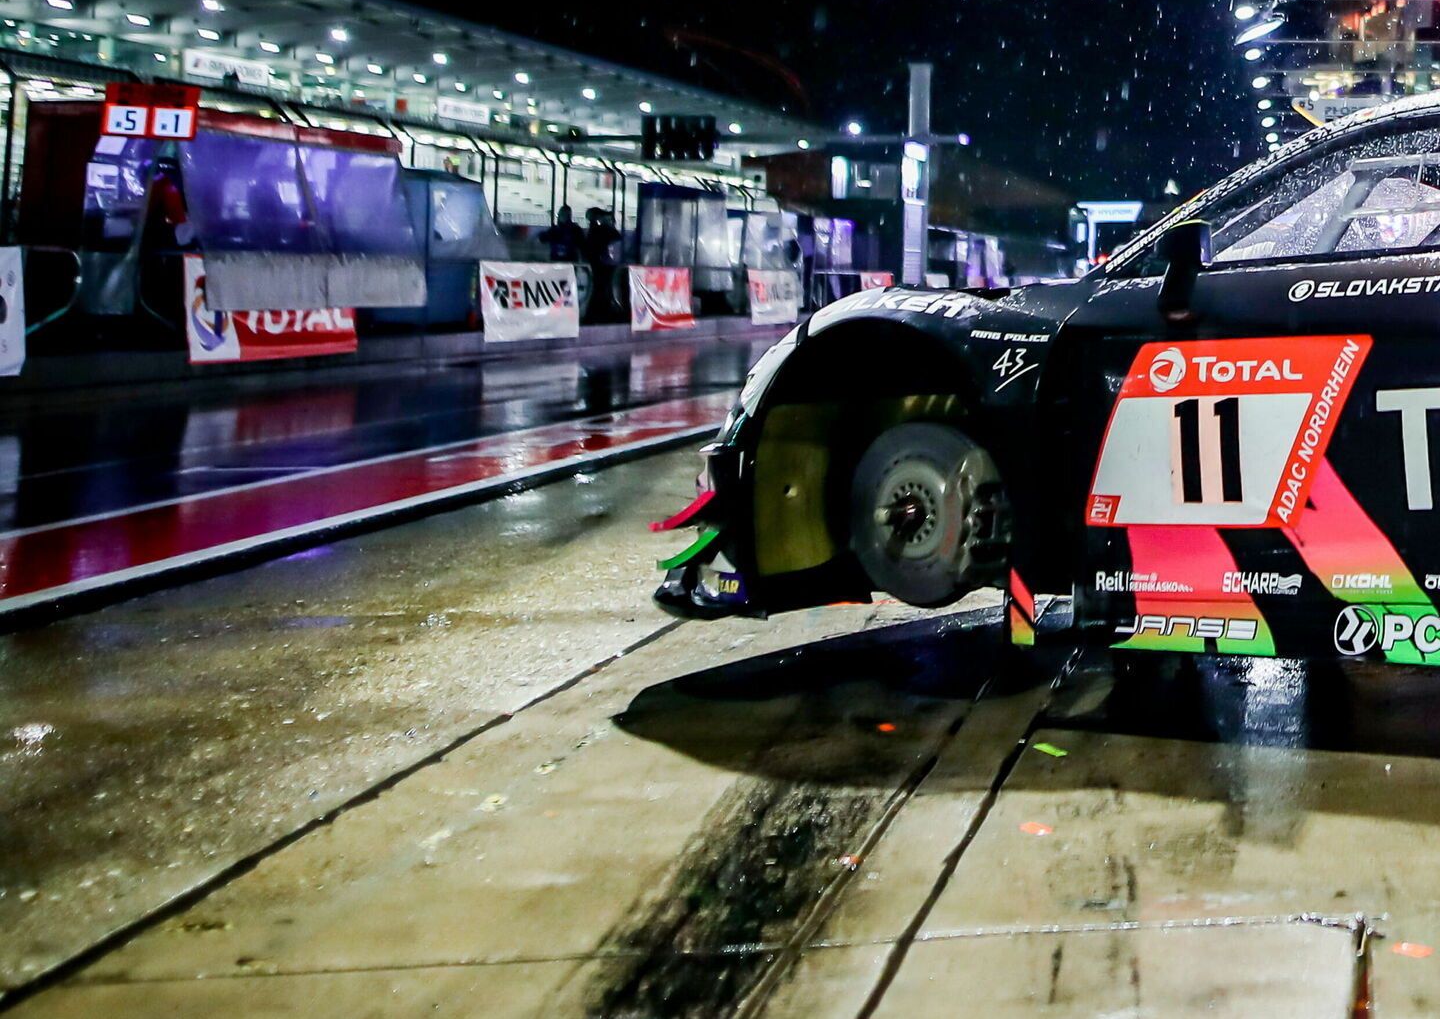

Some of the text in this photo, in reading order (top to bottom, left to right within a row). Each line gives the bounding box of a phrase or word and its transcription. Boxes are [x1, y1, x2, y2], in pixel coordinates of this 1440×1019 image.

[970, 330, 1050, 343] RING POLICE
[992, 347, 1027, 377] 43
[1192, 356, 1303, 383] TOTAL
[1277, 338, 1360, 524] ADAC NORDRHEIN
[1174, 396, 1243, 503] 11
[1096, 571, 1124, 592] Reil
